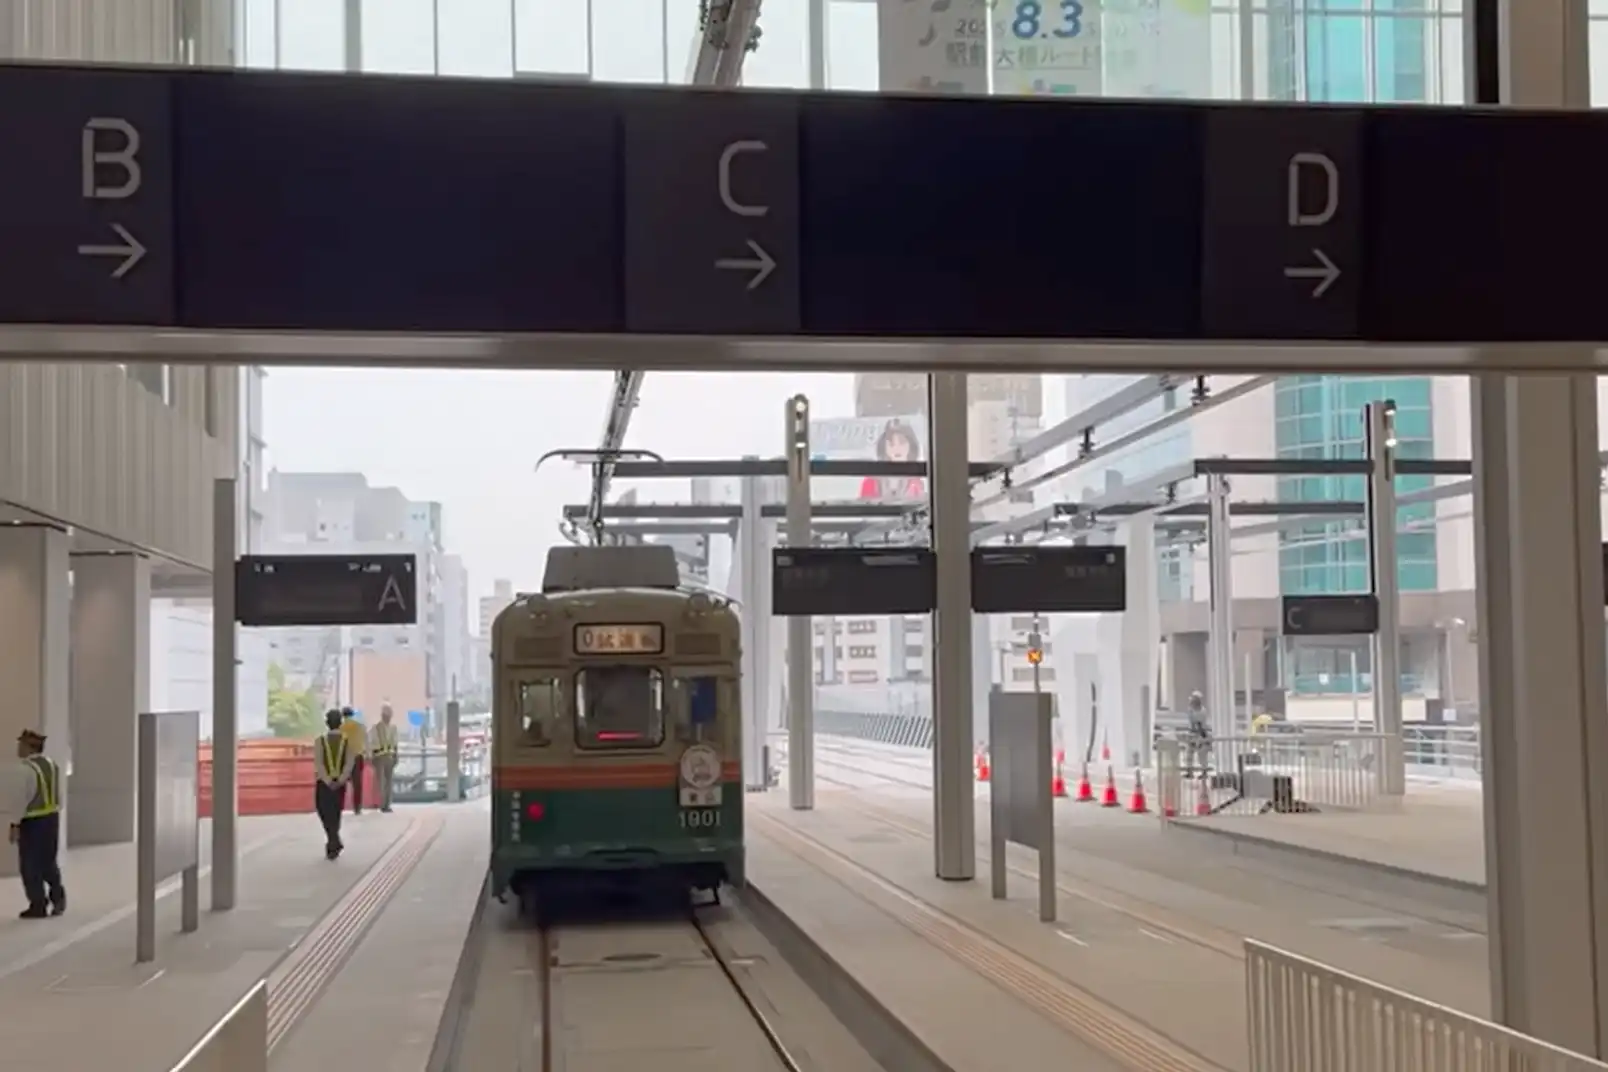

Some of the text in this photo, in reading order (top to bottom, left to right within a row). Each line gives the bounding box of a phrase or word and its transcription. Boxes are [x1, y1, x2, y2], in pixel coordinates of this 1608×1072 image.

[1012, 0, 1083, 38] 8.3
[82, 117, 141, 198] B
[718, 140, 770, 216] C
[1288, 152, 1339, 227] D
[378, 573, 406, 612] A
[1287, 607, 1303, 630] C
[677, 810, 721, 829] 1901
